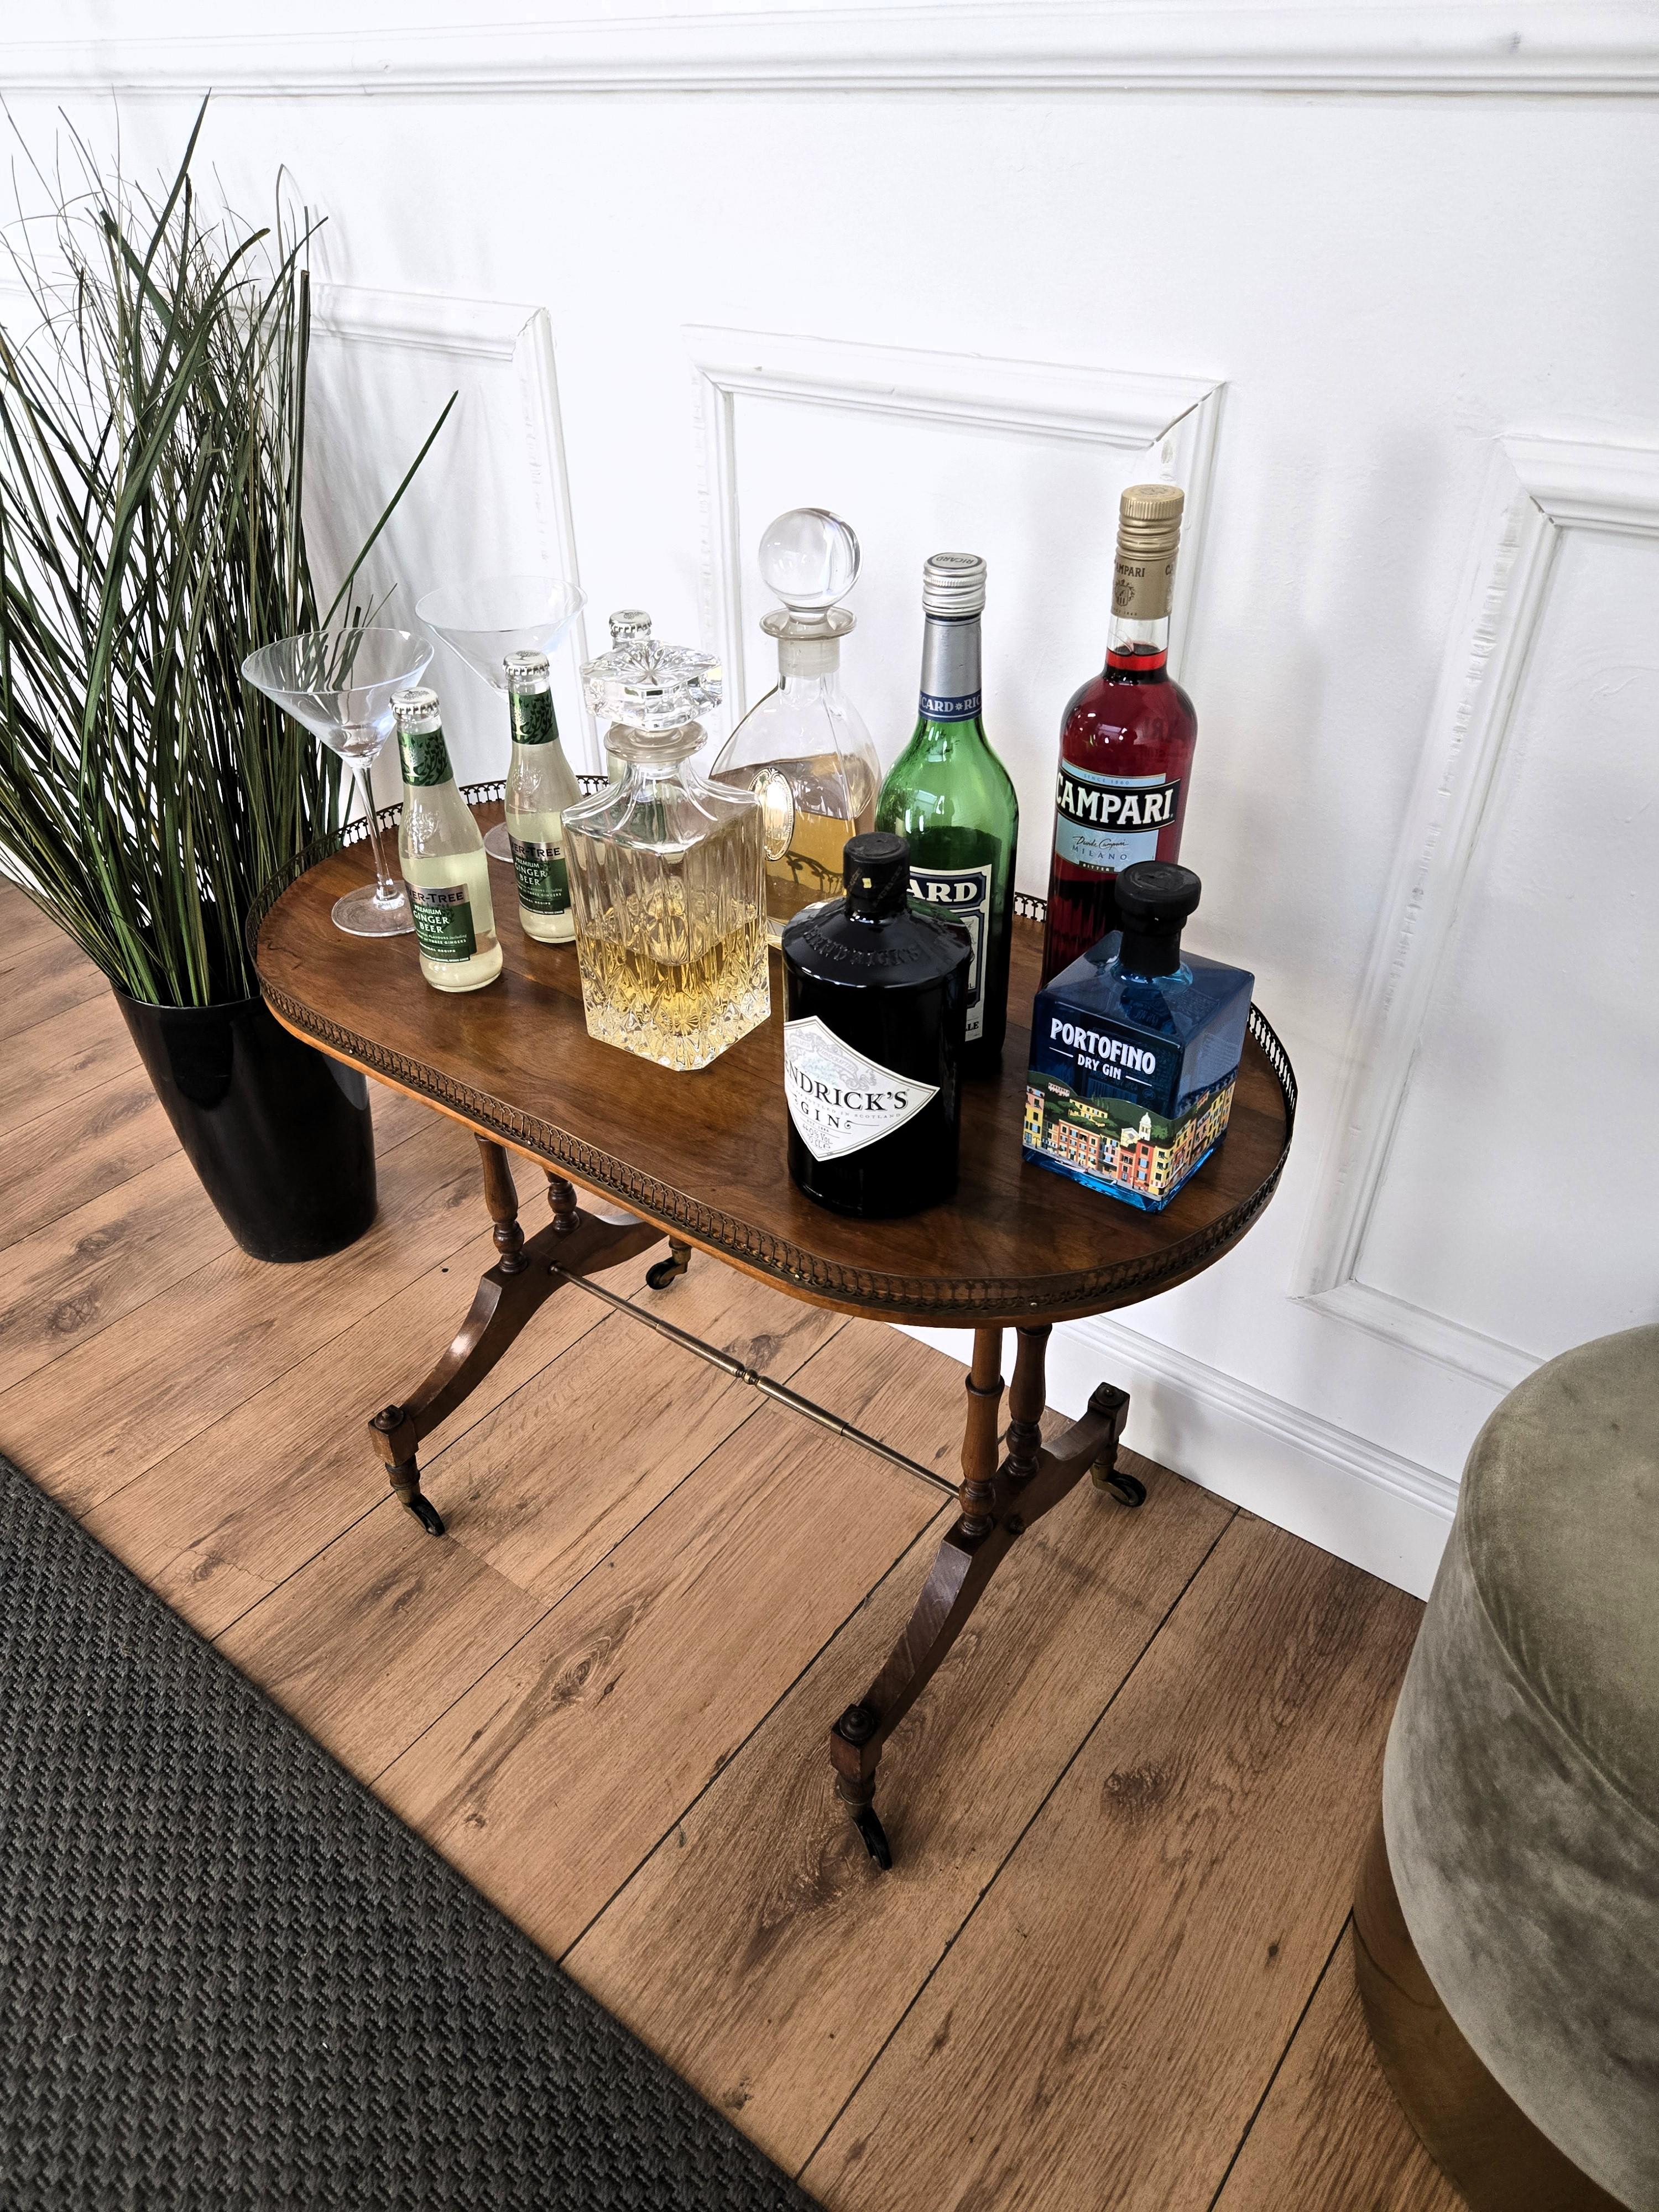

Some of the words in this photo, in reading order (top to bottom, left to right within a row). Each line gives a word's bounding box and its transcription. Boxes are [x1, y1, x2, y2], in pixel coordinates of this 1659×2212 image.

[1083, 774, 1106, 783] SINCE
[1057, 772, 1173, 825] CAMPARI
[1072, 844, 1127, 860] MILANO
[515, 857, 540, 868] PREMIUM
[1083, 863, 1110, 872] BITTER
[514, 863, 547, 877] GINGER
[519, 874, 541, 886] BEER
[414, 904, 442, 915] PREMIUM
[413, 910, 450, 924] GINGER
[419, 921, 444, 933] BEER
[1050, 1018, 1156, 1074] PORTOFINO
[1077, 1053, 1100, 1071] DRY
[1102, 1063, 1122, 1080] GIN
[801, 1101, 841, 1128] GIN
